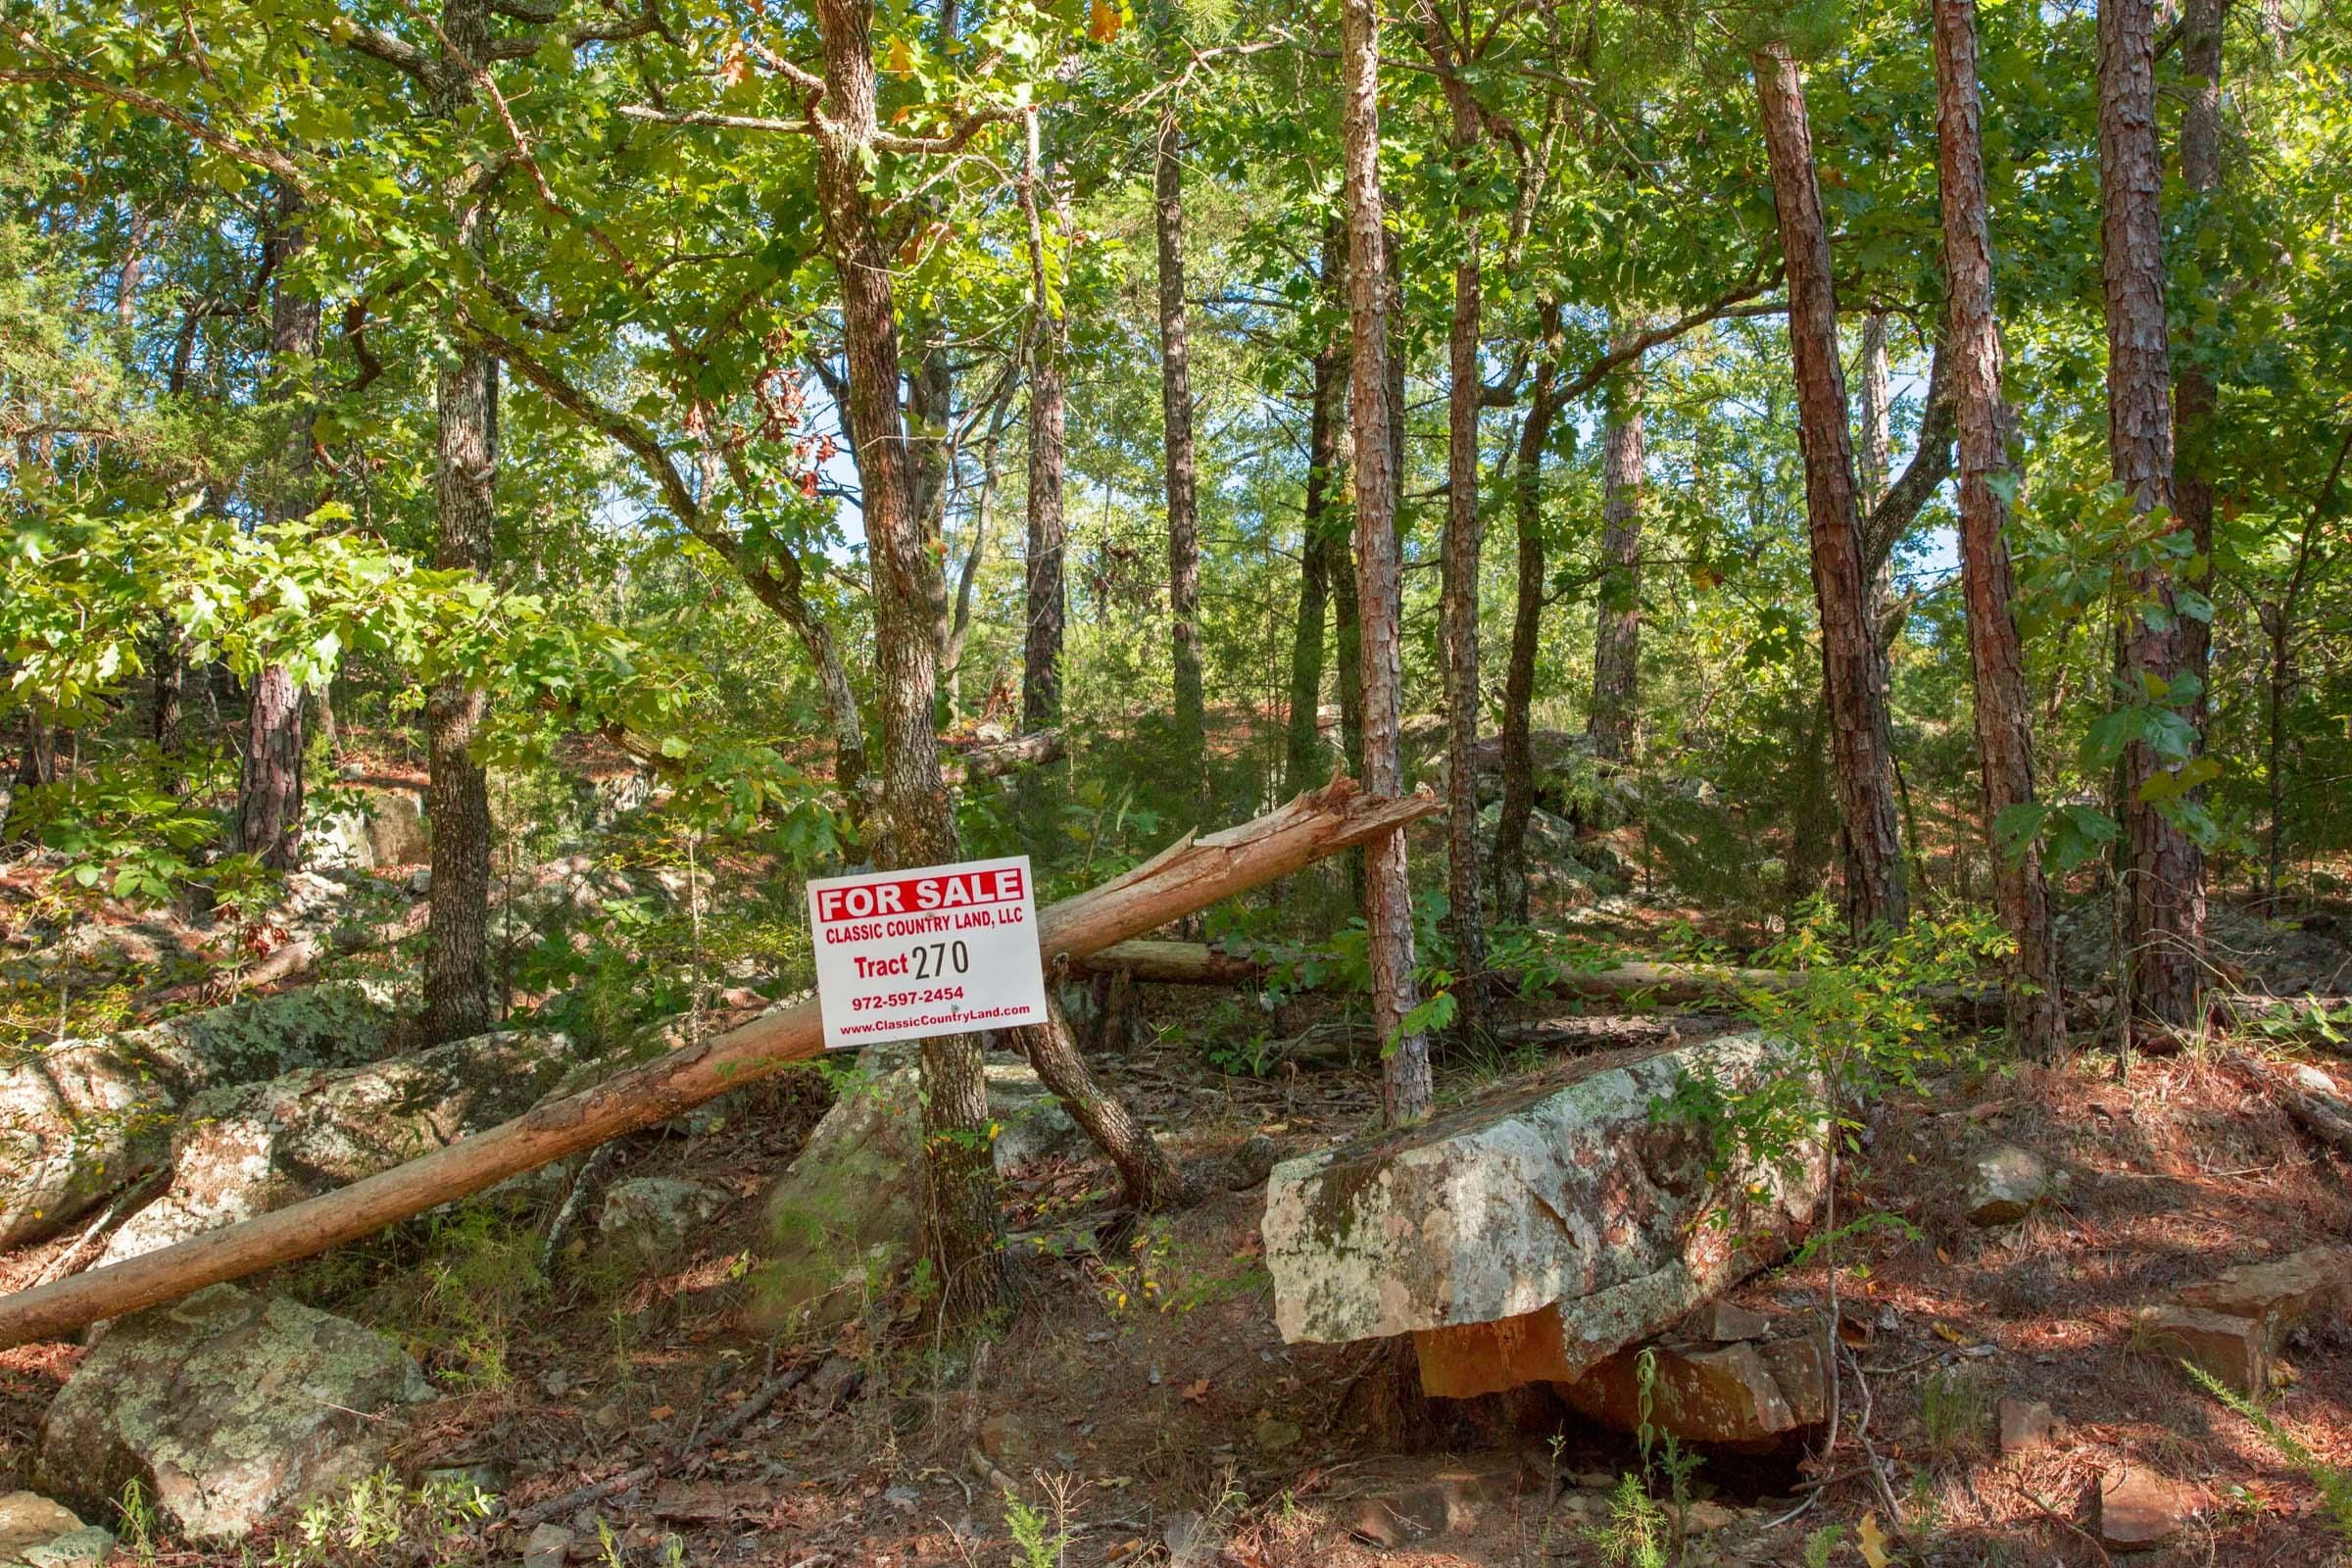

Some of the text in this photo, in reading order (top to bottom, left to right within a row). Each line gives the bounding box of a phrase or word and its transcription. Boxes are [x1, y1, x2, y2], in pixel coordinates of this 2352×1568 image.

[821, 869, 1020, 920] FOR SALE
[826, 907, 1022, 944] CLASSIC COUNTRY LAND, LLC
[855, 941, 969, 980] Tract 270
[853, 987, 964, 1010] 972-597-2454
[841, 1004, 1030, 1035] www.ClassicCountryLand.com
